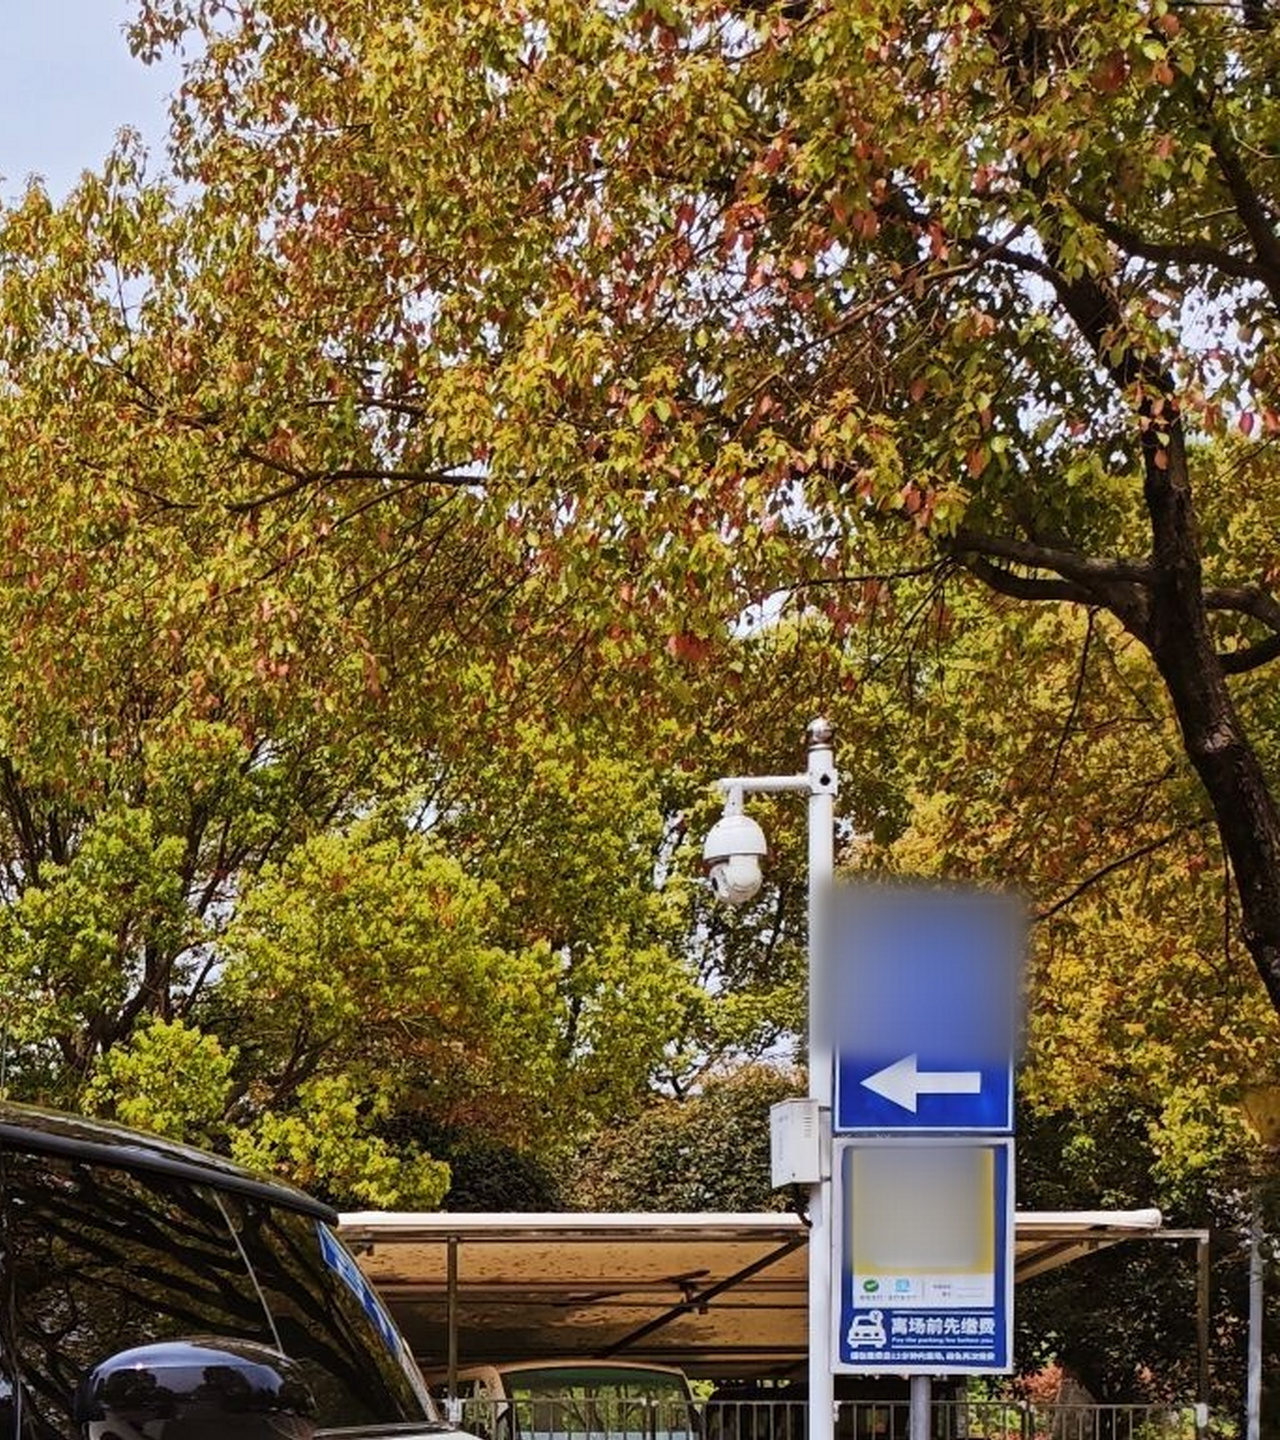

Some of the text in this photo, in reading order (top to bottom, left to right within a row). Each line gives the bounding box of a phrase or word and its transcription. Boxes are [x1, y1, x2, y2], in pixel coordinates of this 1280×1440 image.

[891, 1317, 996, 1335] 离场前先缴费
